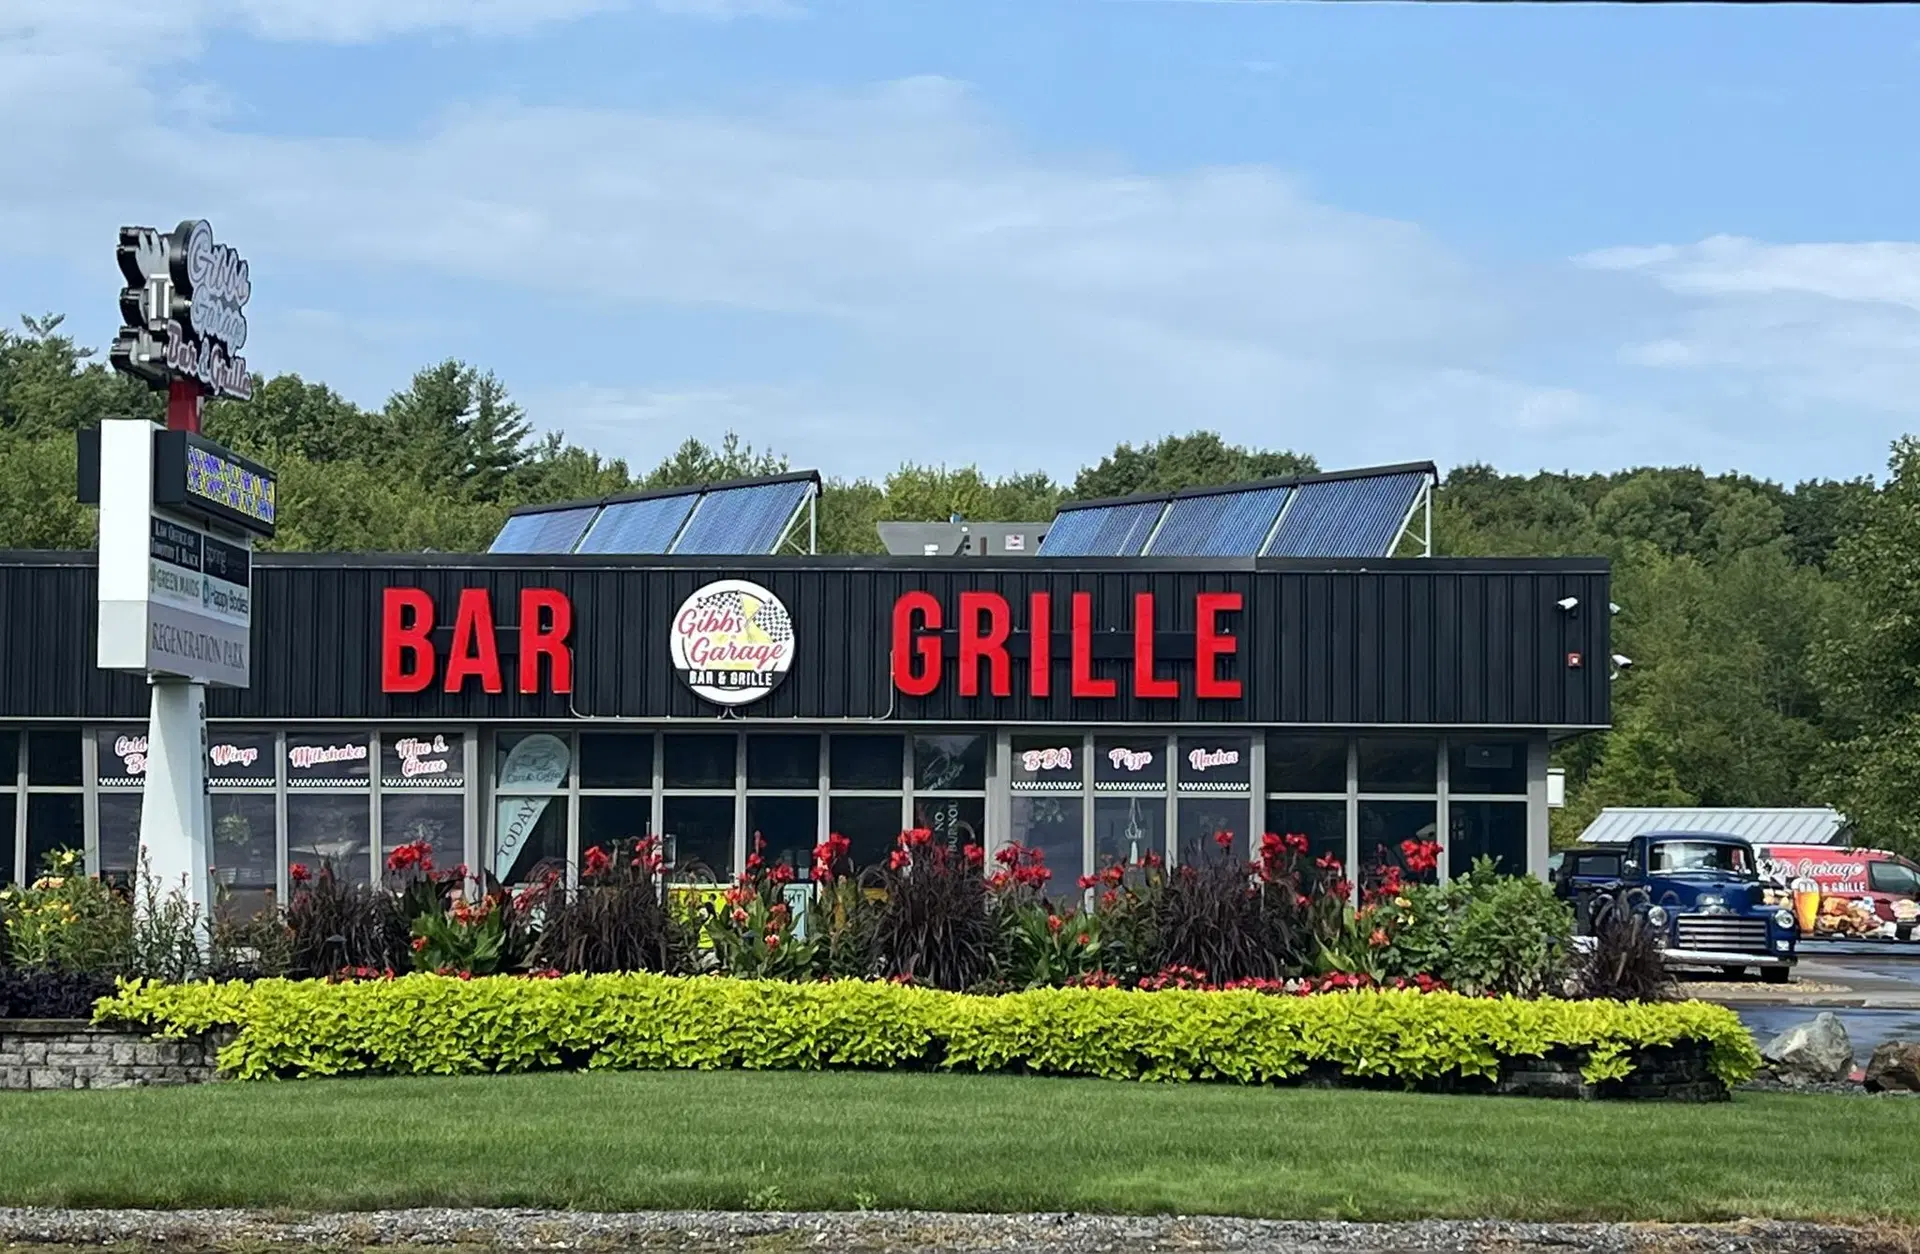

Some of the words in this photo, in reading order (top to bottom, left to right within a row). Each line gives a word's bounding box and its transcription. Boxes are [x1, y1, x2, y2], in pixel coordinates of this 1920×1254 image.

[678, 608, 743, 639] Gibbs
[152, 622, 223, 662] REGENERATION
[223, 640, 245, 670] PARK
[382, 588, 572, 693] BAR
[892, 590, 1243, 698] GRILLE
[690, 637, 787, 669] Garage
[689, 671, 714, 685] BAR
[718, 672, 726, 685] &
[730, 672, 773, 686] GRILLE
[115, 735, 148, 757] Cold
[210, 744, 258, 767] Wings
[289, 743, 366, 768] Milkshakes
[395, 738, 432, 759] Mac
[433, 735, 449, 753] &
[402, 757, 448, 777] Cheese
[1022, 747, 1072, 772] BBQ
[1108, 748, 1153, 771] Pizza
[1188, 748, 1239, 771] Nachos
[1798, 858, 1864, 882] Garage
[1832, 881, 1866, 893] GRILLE
